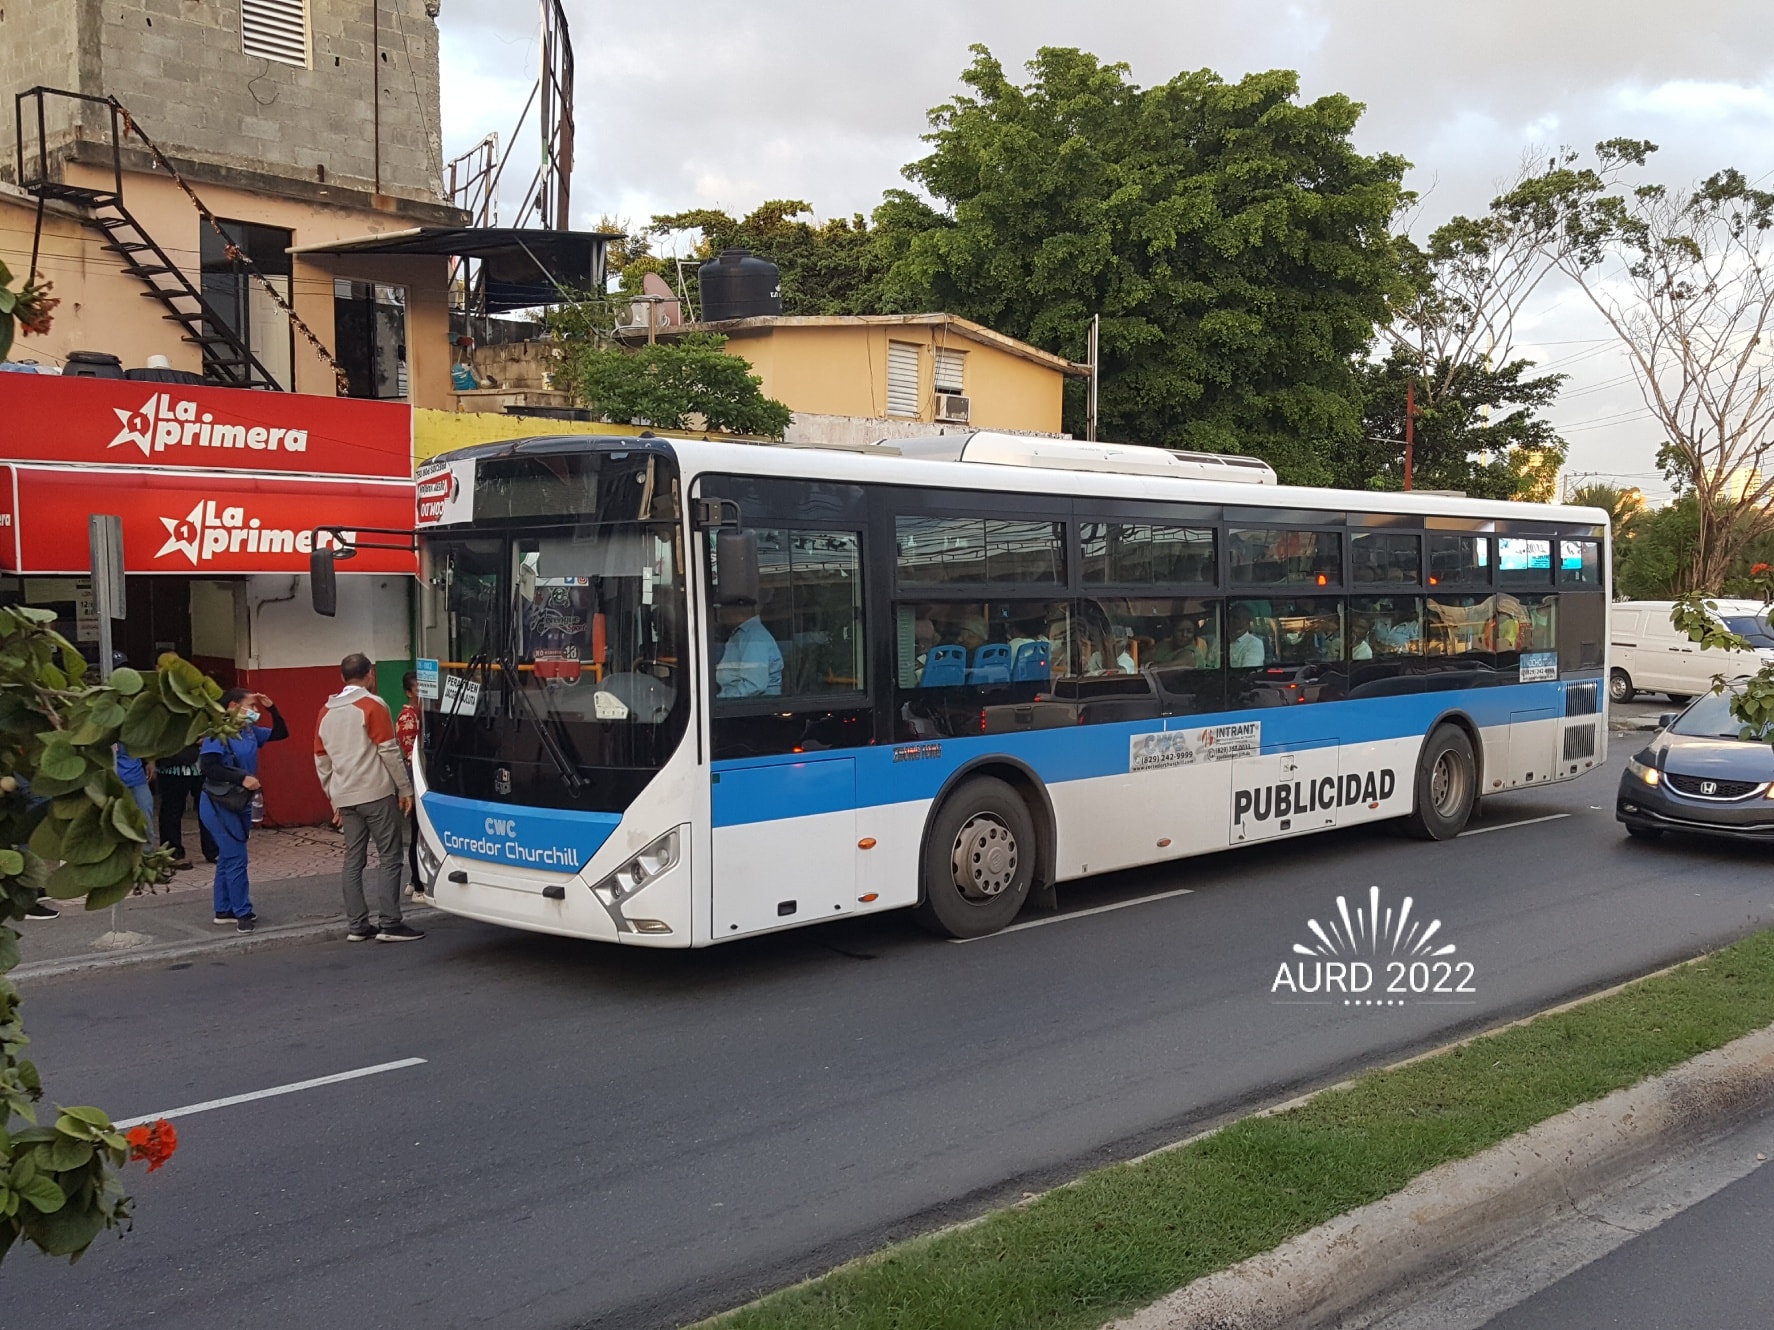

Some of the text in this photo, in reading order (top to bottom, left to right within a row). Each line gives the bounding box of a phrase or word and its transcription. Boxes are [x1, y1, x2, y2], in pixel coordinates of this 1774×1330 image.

[158, 393, 197, 421] La
[154, 413, 309, 453] primera
[205, 500, 244, 527] La
[1216, 724, 1255, 738] INTRANT
[1141, 755, 1159, 765] (829)
[1234, 768, 1396, 826] PUBLICIDAD
[484, 817, 517, 838] CWC
[443, 831, 579, 867] Corredor Churchill
